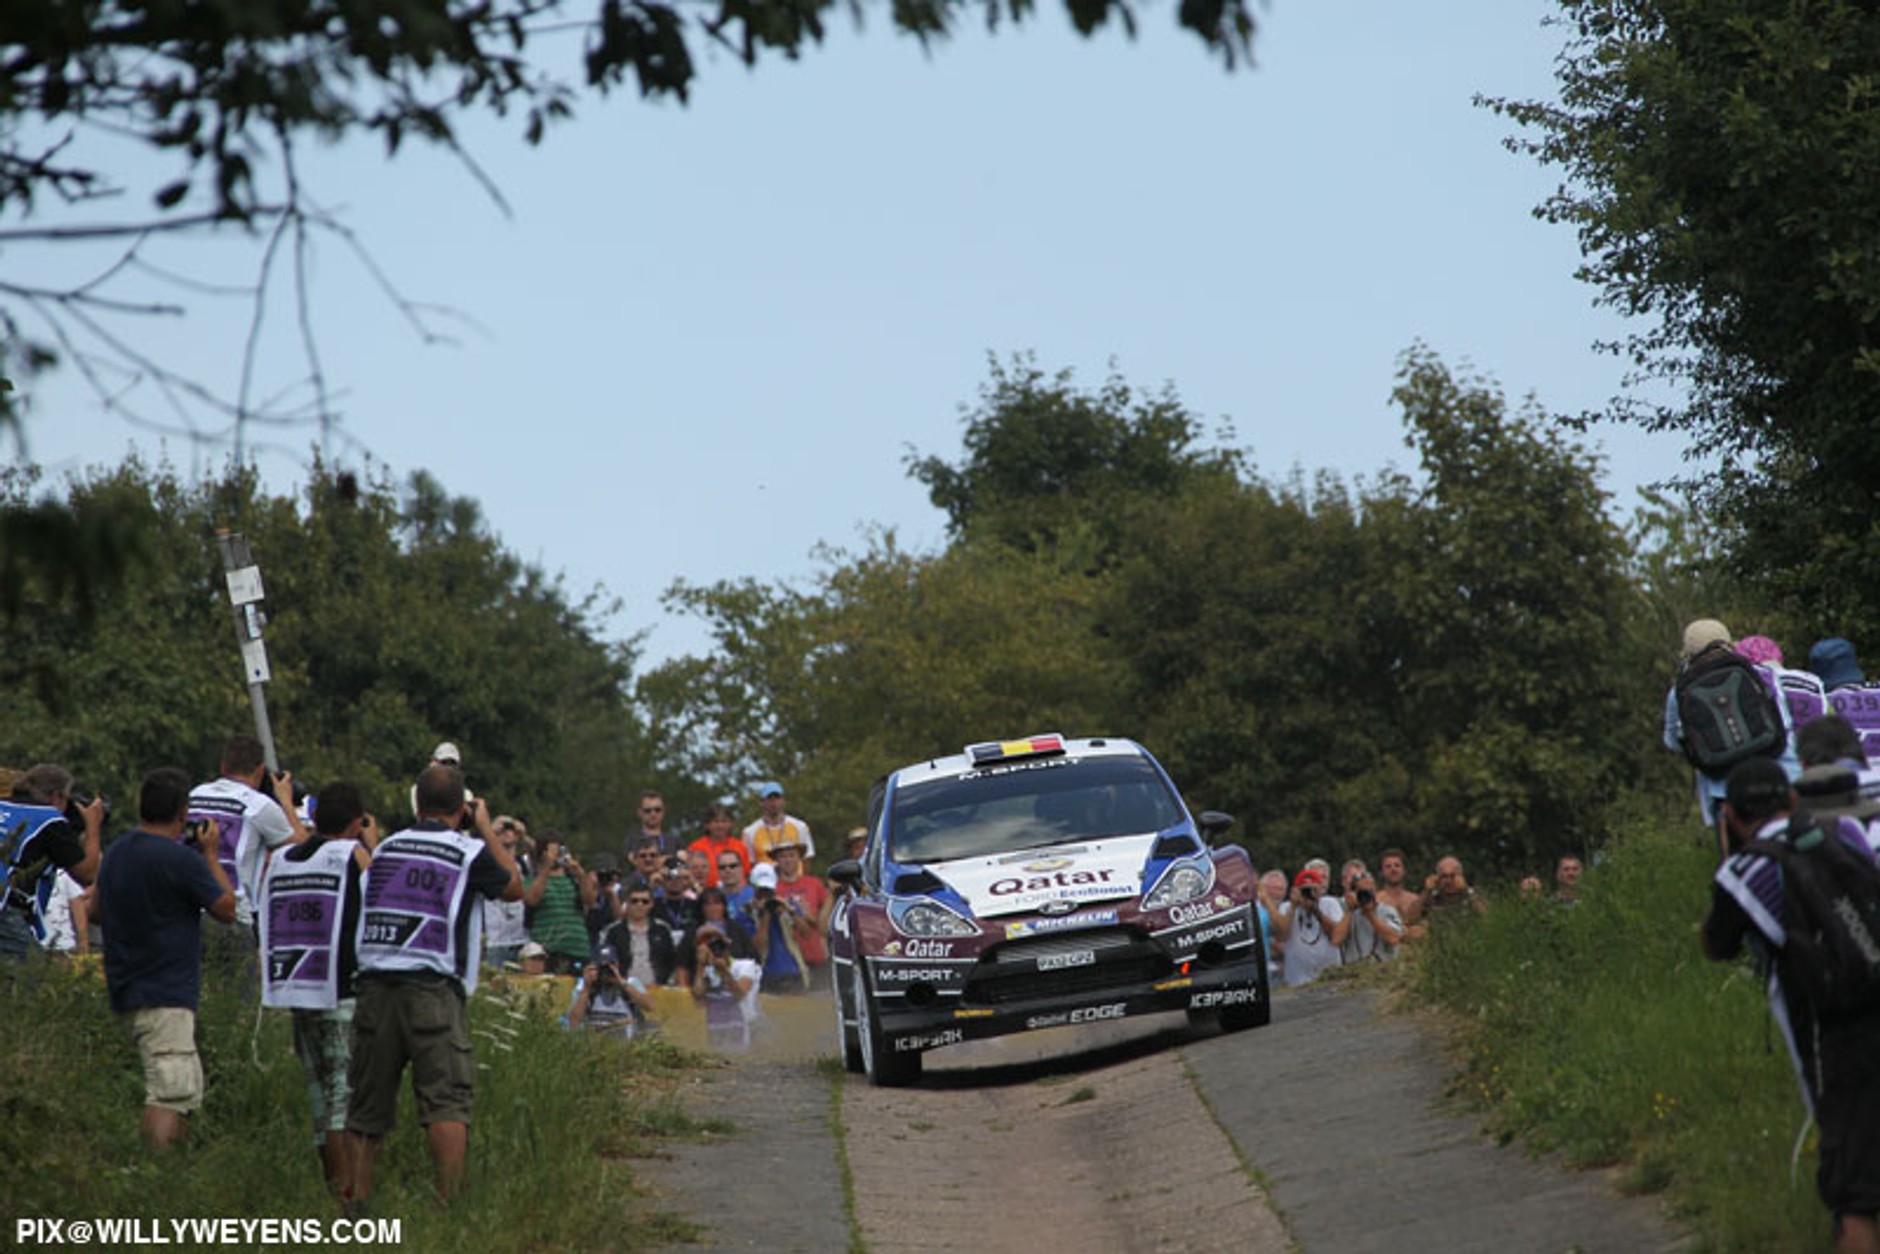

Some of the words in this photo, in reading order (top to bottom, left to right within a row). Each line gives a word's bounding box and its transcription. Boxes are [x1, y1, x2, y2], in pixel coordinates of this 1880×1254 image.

[989, 868, 1116, 896] Qatar
[1035, 910, 1114, 931] MICHELIN
[1169, 902, 1214, 925] Qatar
[1177, 919, 1245, 948] M-SPORT
[904, 939, 953, 957] Qatar
[879, 968, 954, 981] M-SPORT
[1070, 1003, 1127, 1023] EDGE
